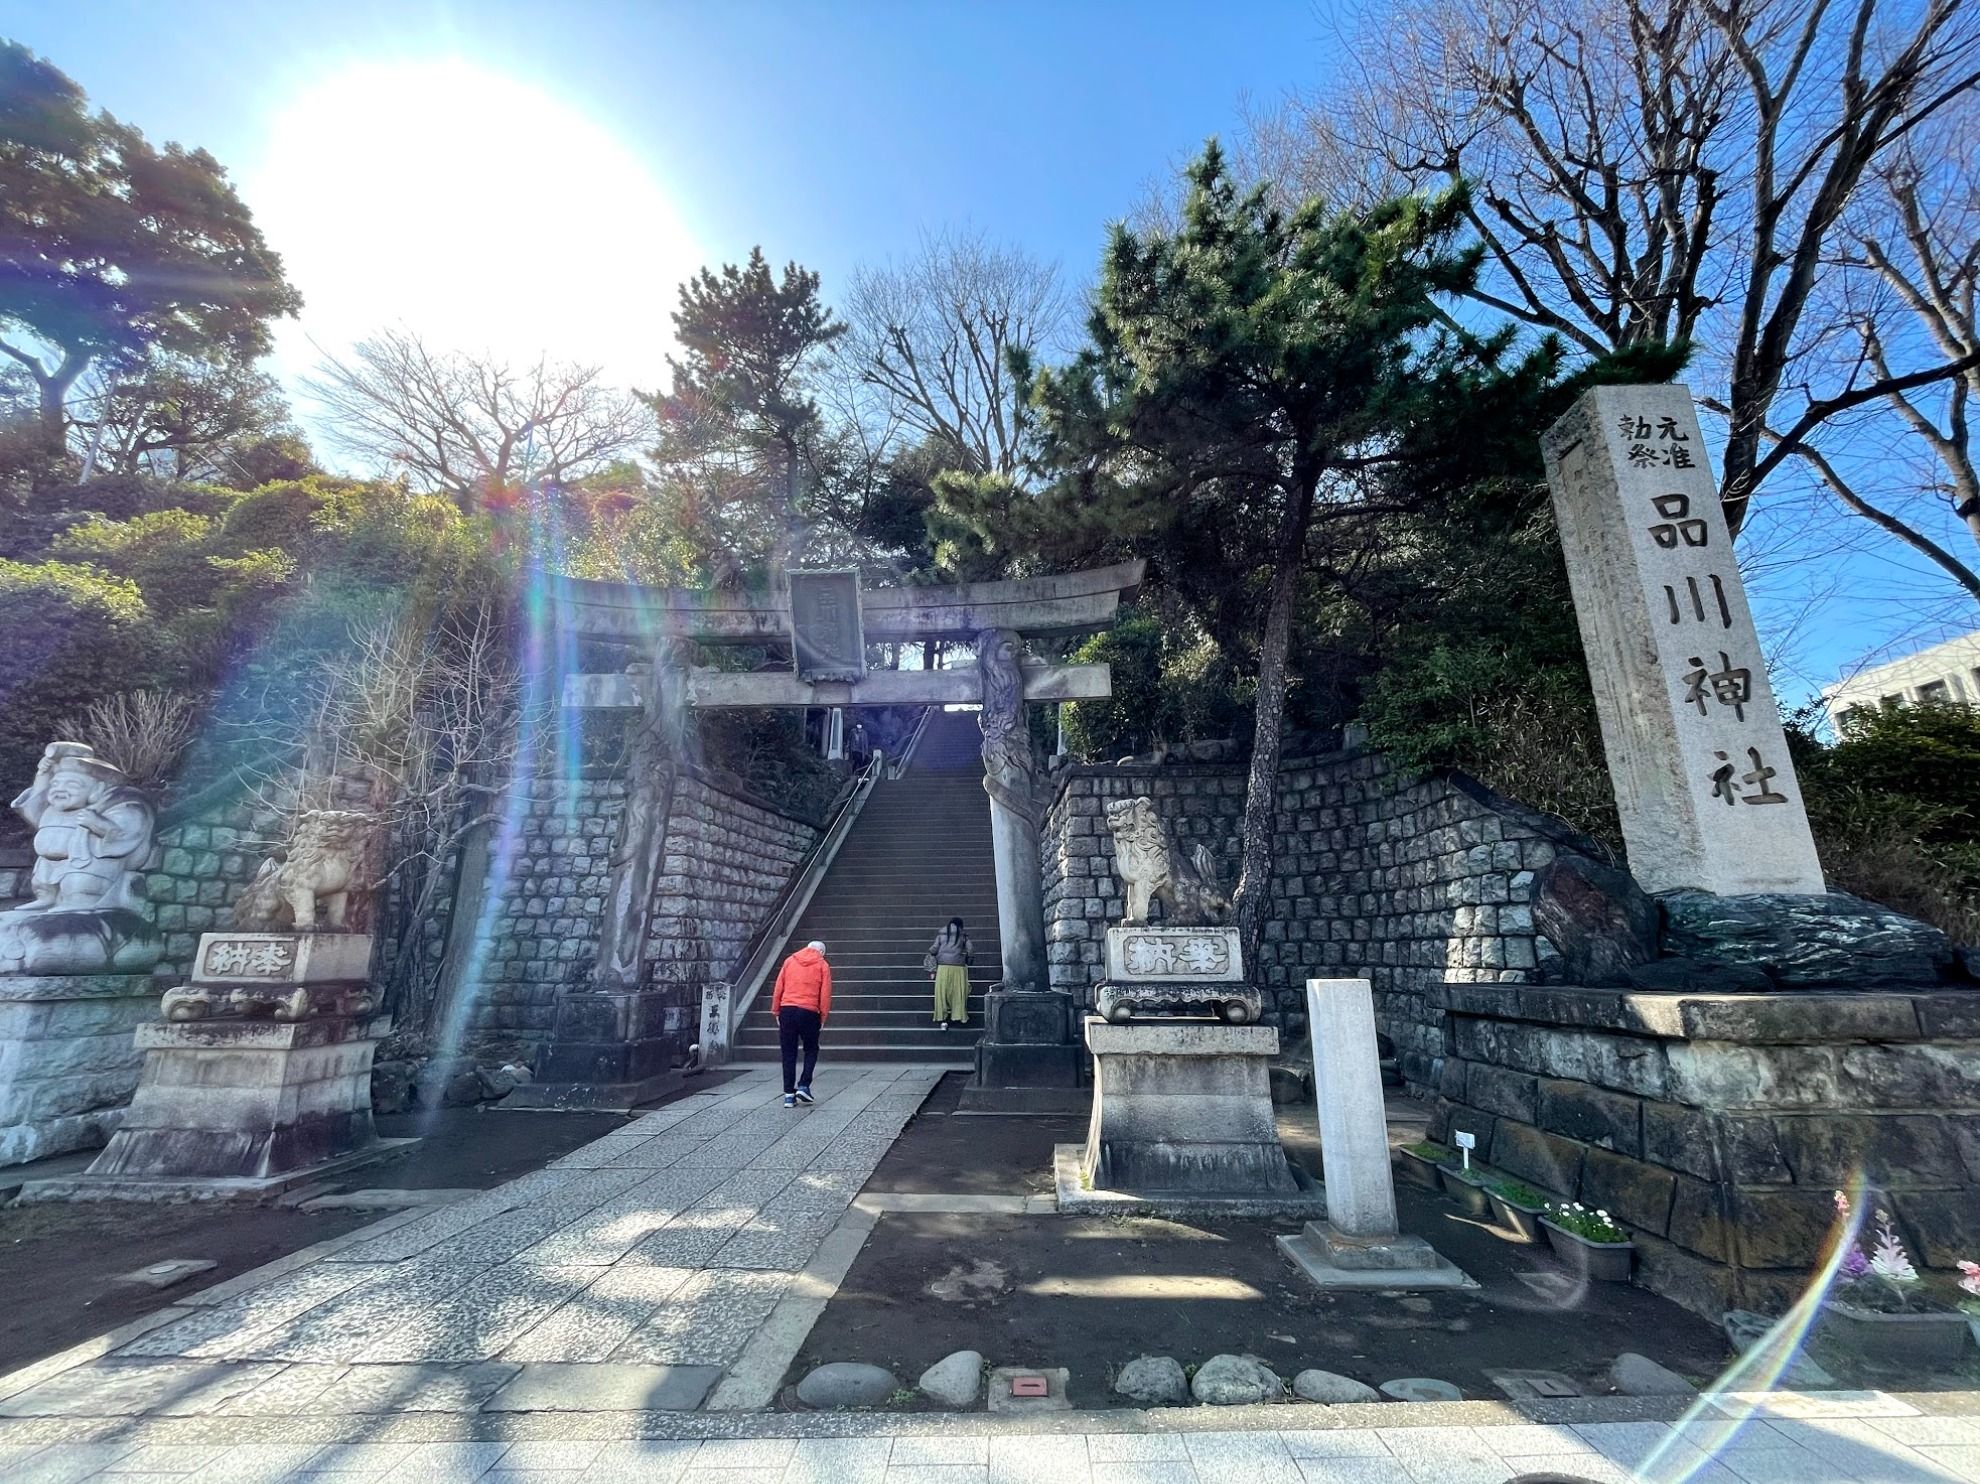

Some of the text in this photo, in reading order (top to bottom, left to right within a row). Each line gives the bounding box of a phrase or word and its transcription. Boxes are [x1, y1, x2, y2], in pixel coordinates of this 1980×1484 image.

[1657, 416, 1696, 468] 元准
[1647, 493, 1788, 806] 品川神社
